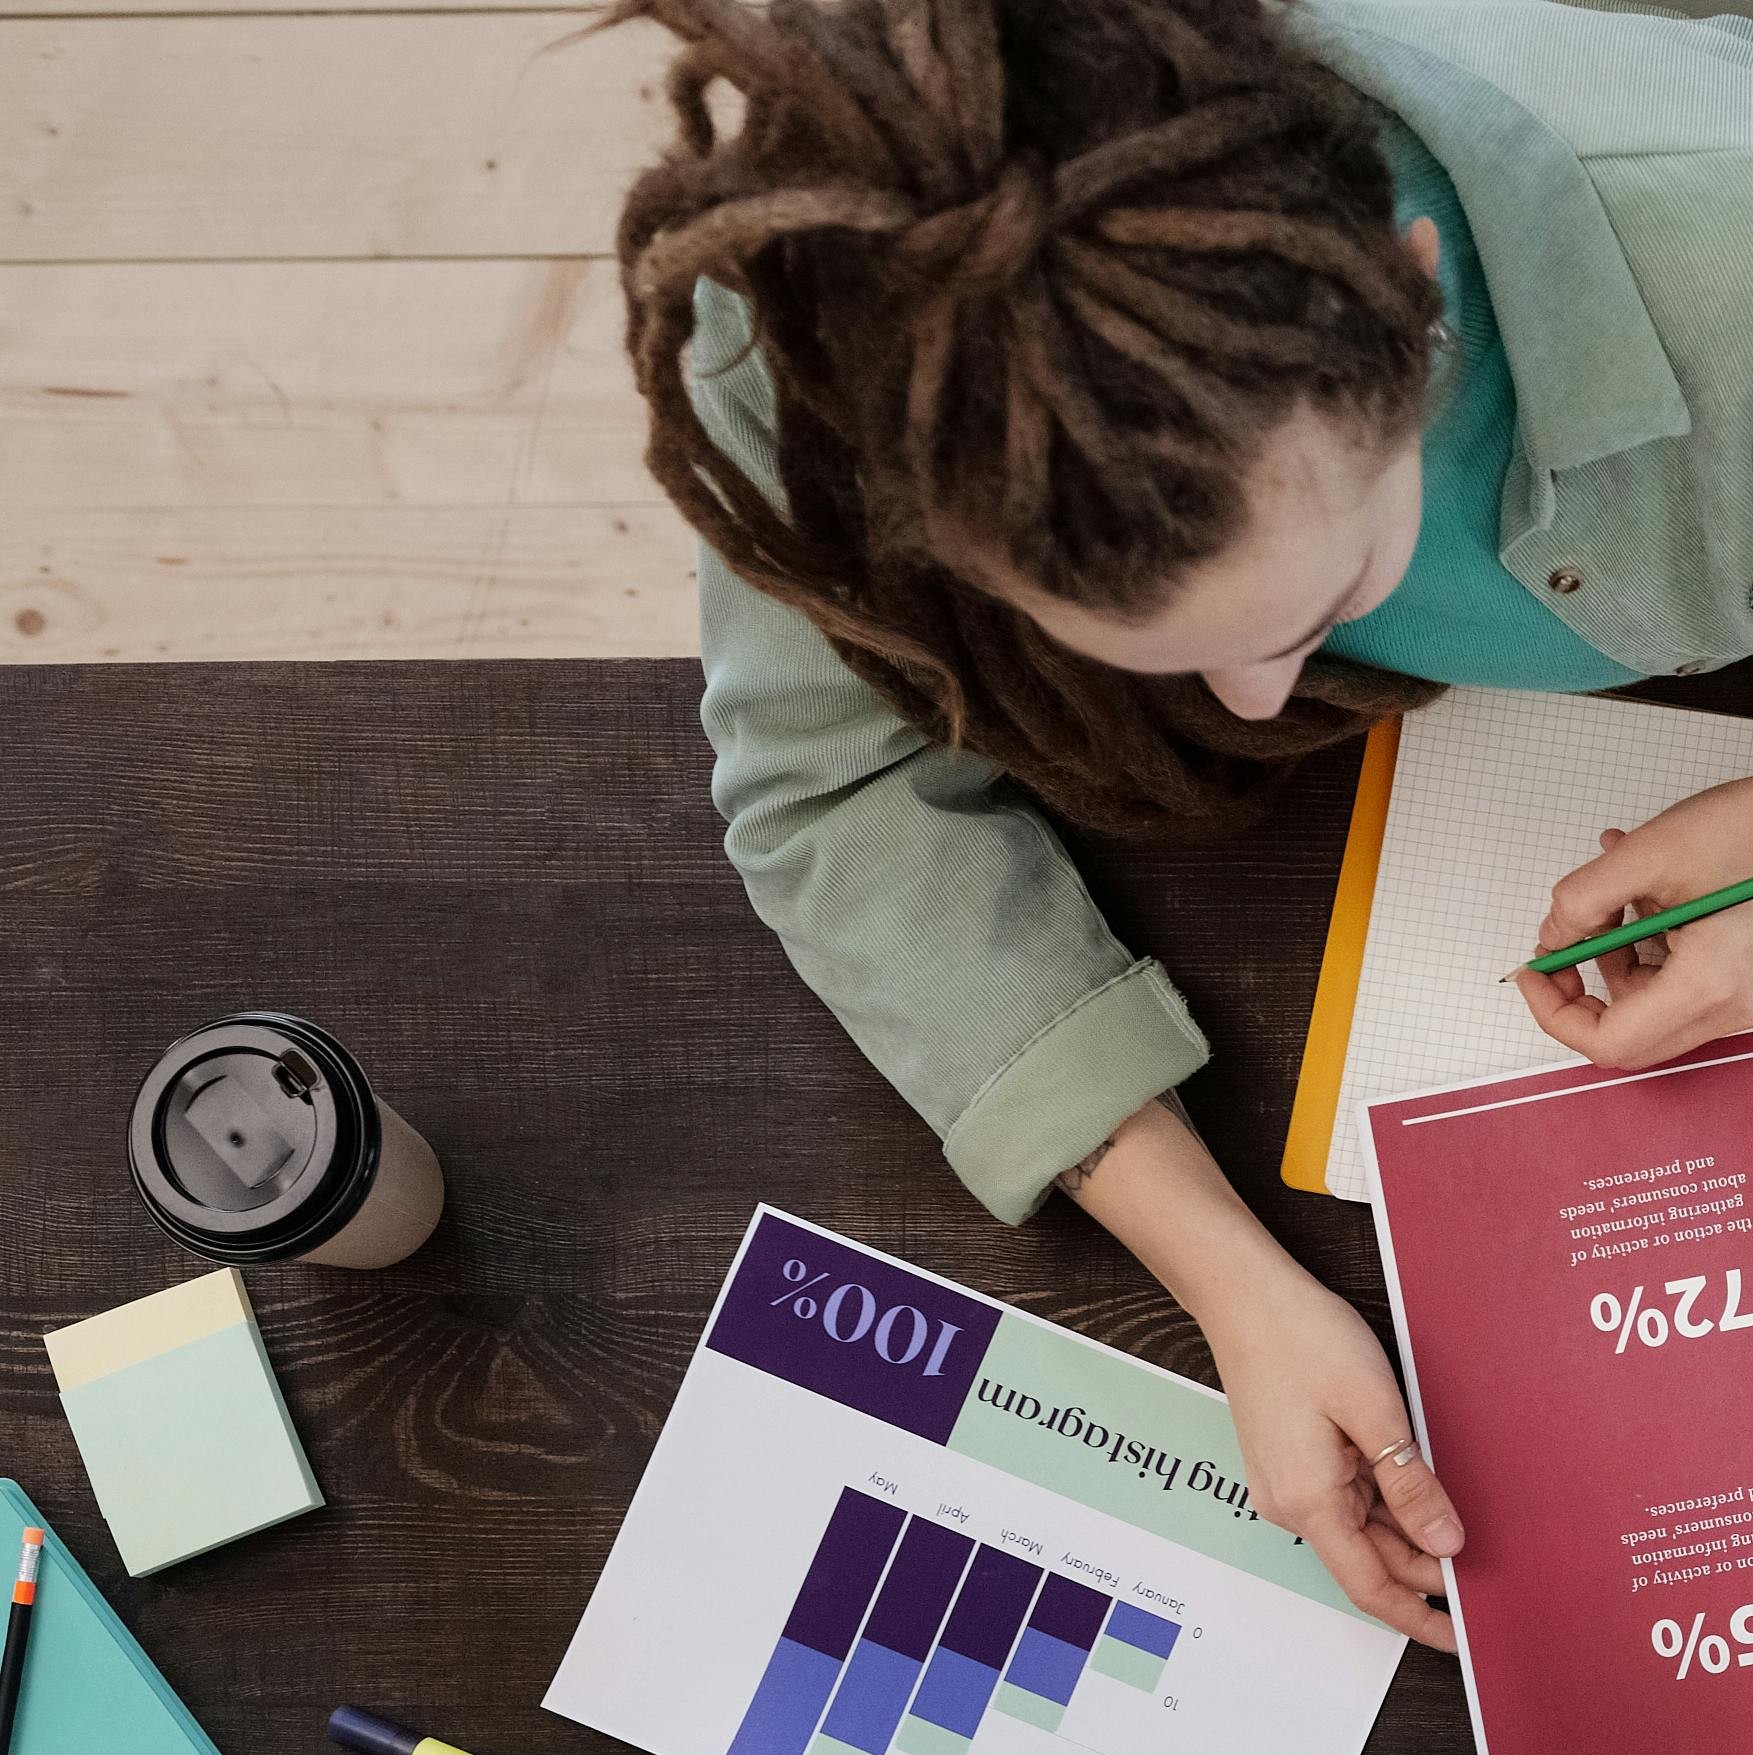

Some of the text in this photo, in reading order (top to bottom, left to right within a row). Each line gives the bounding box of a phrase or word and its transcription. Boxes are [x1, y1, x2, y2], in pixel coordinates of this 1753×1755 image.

[1584, 1157, 1714, 1190] and preferences.
[1560, 1174, 1746, 1220] about consumers' needs
[1571, 1194, 1743, 1239] gathering information
[1571, 1218, 1752, 1266] the action or activity of
[770, 1260, 963, 1376] 100%
[978, 1378, 1183, 1491] histagram
[868, 1472, 898, 1495] May
[936, 1504, 970, 1524] April
[1645, 1487, 1744, 1516] preferences.
[1001, 1529, 1043, 1555] March
[1621, 1528, 1667, 1546] needs
[1632, 1540, 1727, 1565] information
[1061, 1552, 1119, 1587] February
[1654, 1565, 1710, 1585] activity
[1716, 1562, 1732, 1572] or
[1632, 1577, 1647, 1592] of
[1132, 1582, 1185, 1615] January
[1193, 1627, 1202, 1638] 0
[1164, 1696, 1178, 1711] 10
